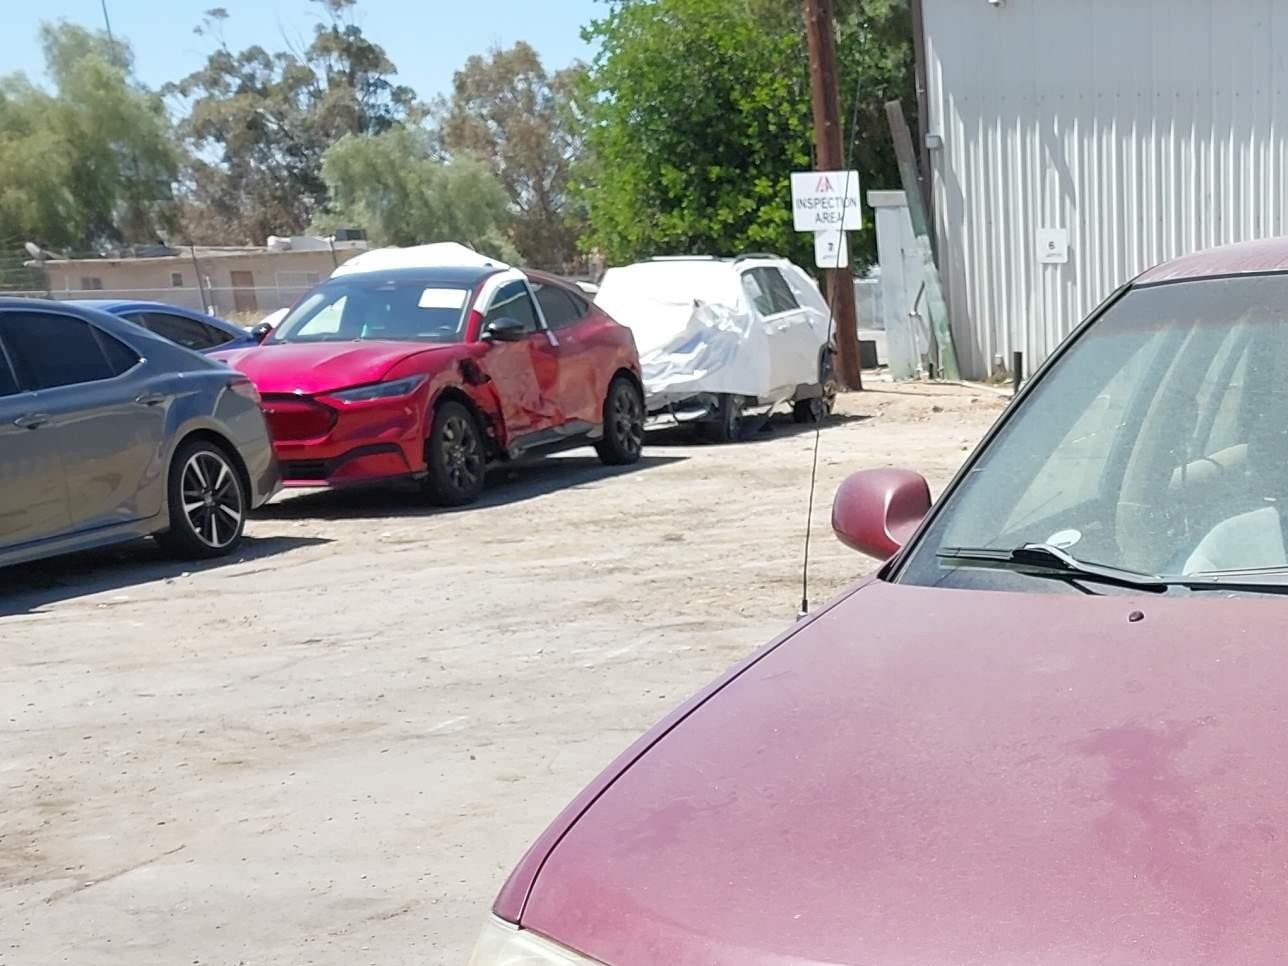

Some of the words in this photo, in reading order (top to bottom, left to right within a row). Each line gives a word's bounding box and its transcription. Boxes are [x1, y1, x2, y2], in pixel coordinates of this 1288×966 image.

[797, 197, 857, 209] INSPECTION
[815, 211, 842, 224] AREA
[1048, 240, 1056, 250] 6
